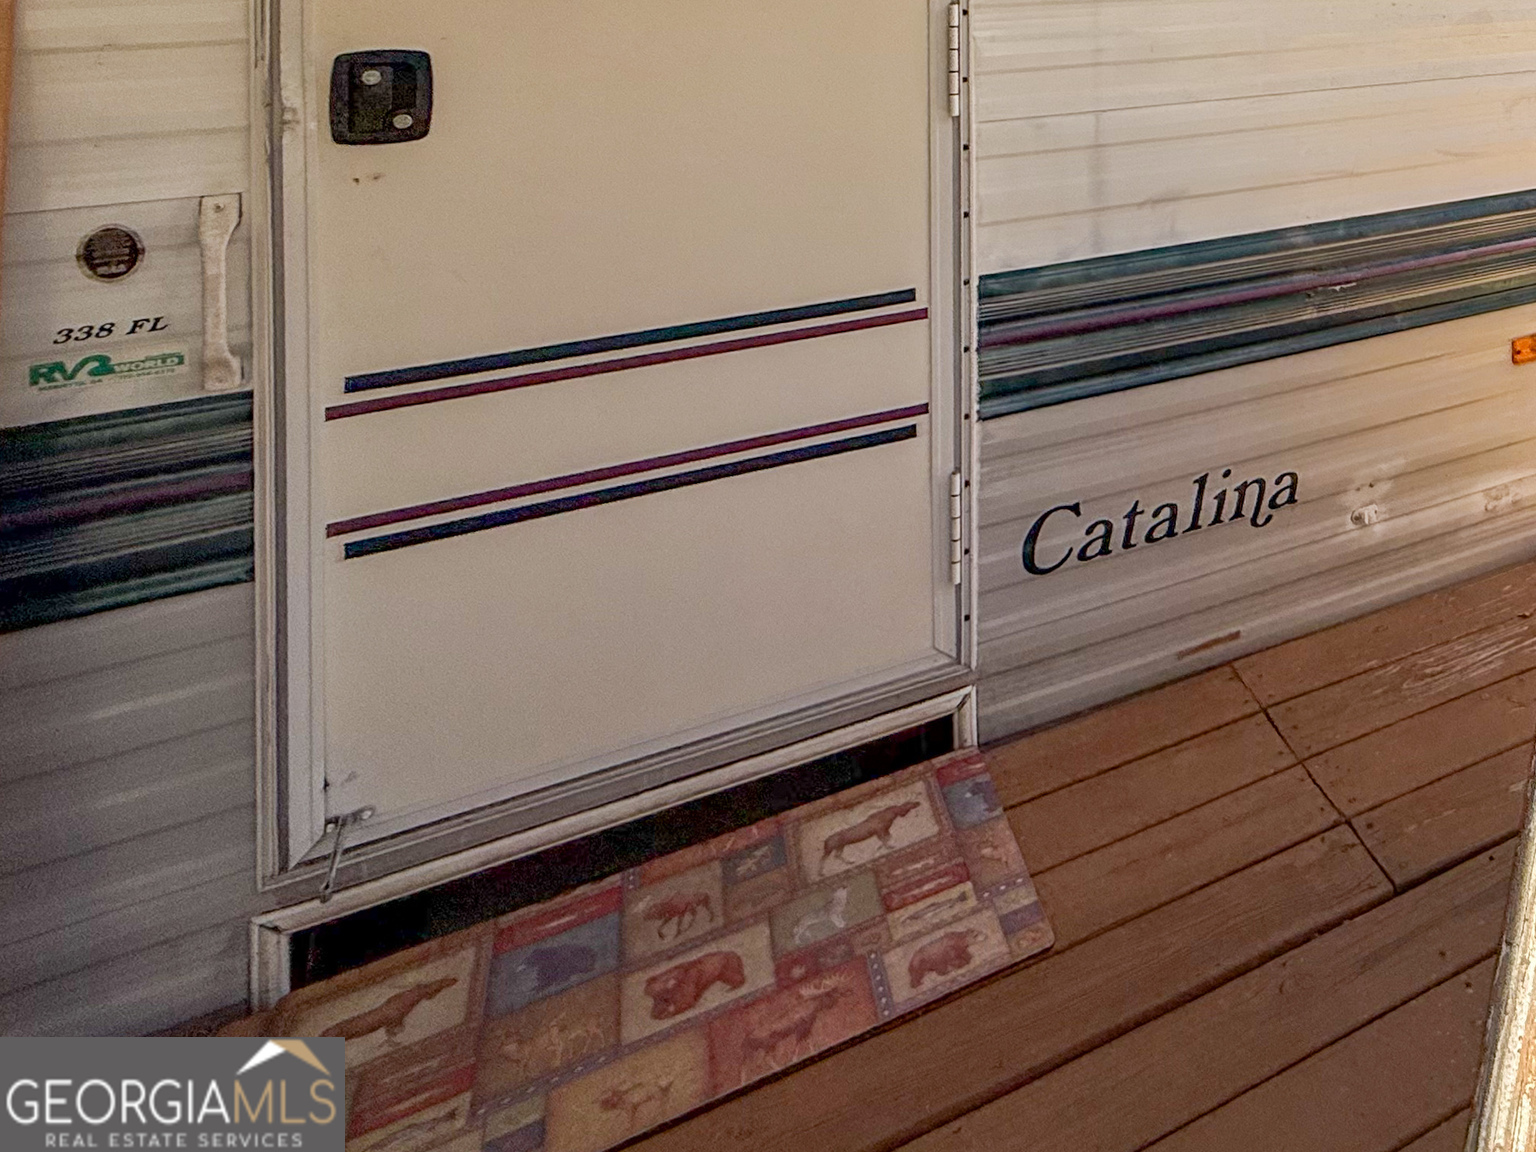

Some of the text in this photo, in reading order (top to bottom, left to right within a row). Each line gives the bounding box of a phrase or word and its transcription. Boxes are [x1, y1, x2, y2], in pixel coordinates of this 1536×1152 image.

[53, 317, 170, 345] 338 FL
[113, 356, 179, 373] WORLD
[1022, 468, 1299, 576] Catalina
